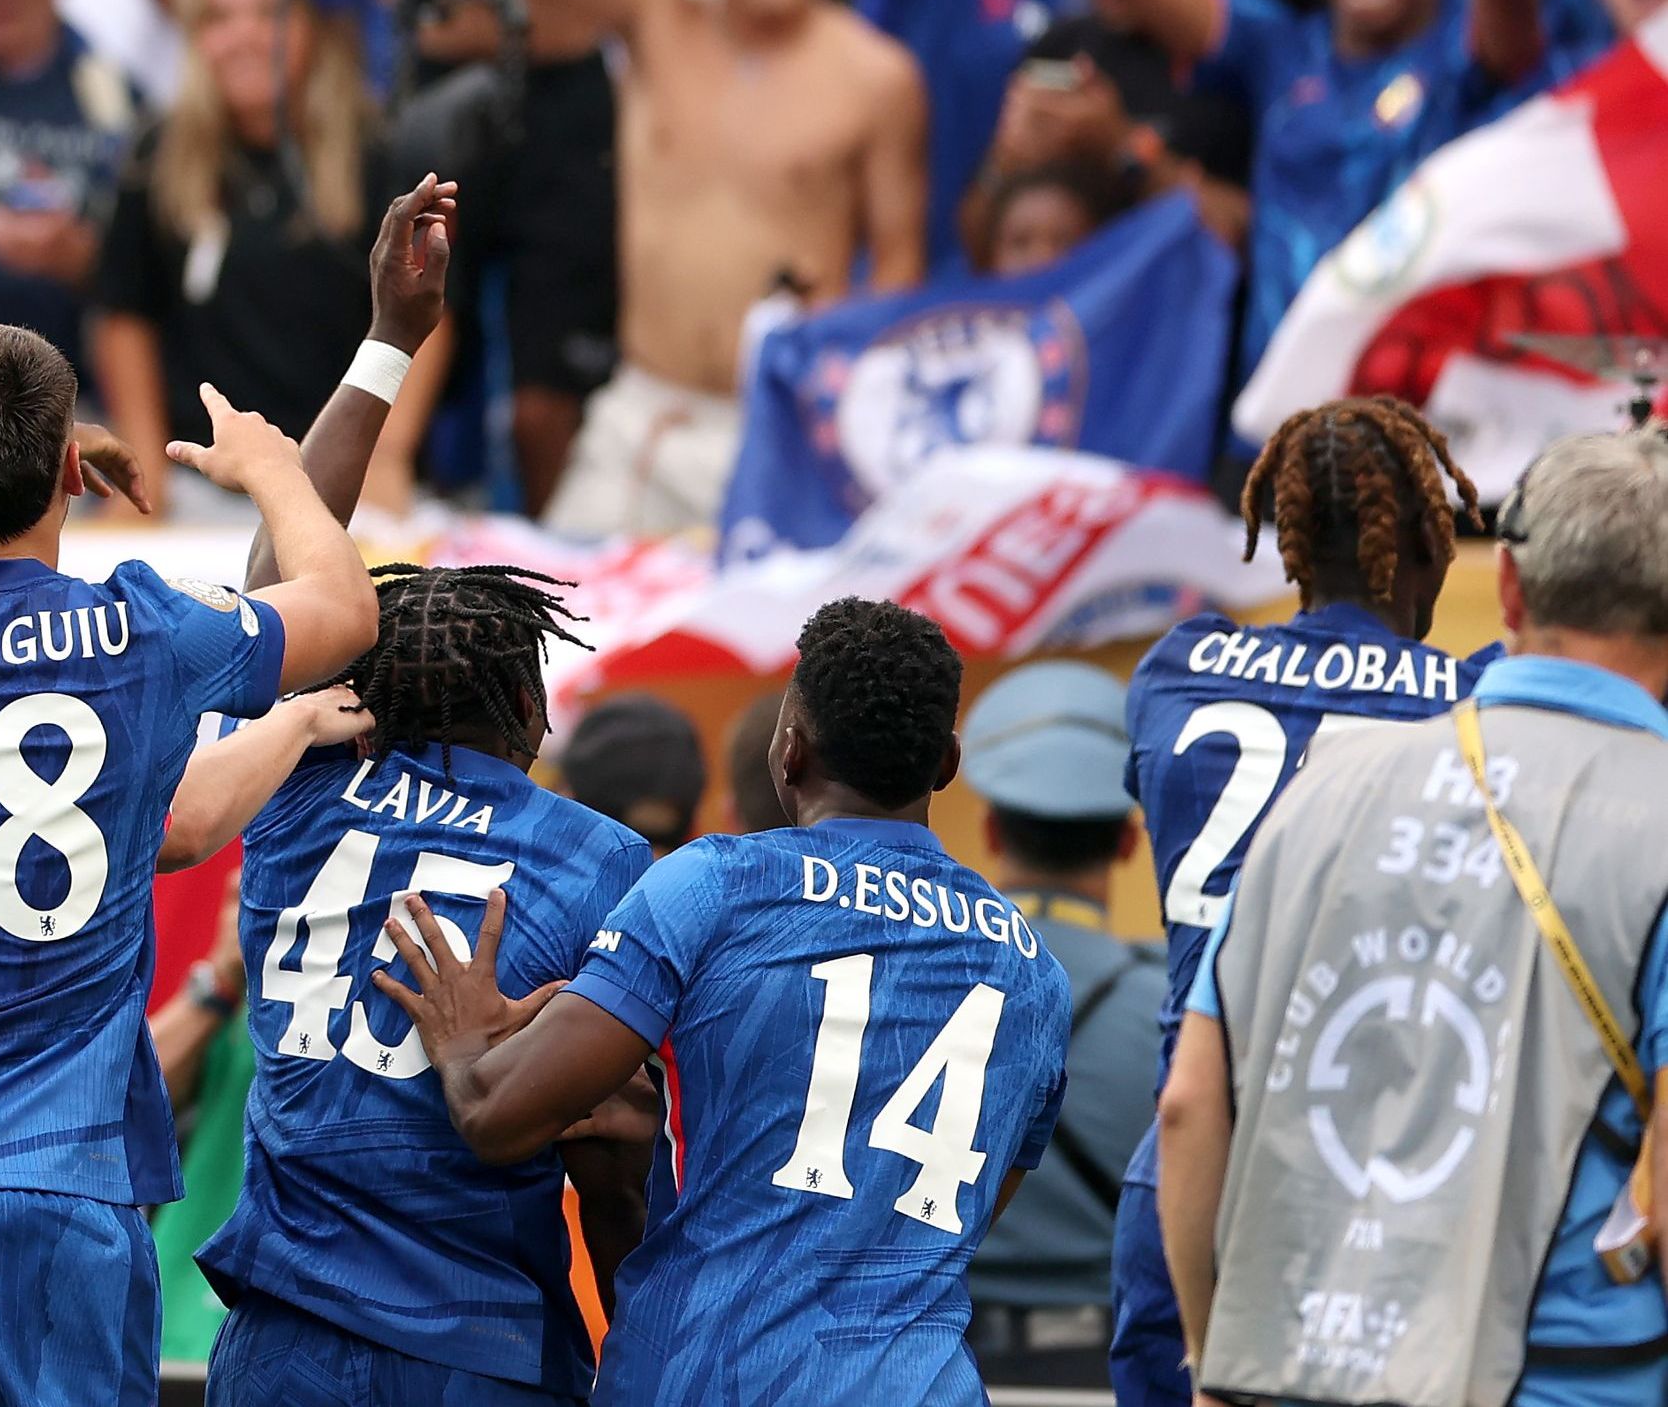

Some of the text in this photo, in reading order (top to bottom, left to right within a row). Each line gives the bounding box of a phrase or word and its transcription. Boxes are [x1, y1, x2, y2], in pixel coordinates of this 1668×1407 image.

[1, 602, 130, 665] GUIU
[1188, 630, 1458, 702] CHALOBAH
[340, 758, 494, 835] LAVIA
[1376, 815, 1502, 889] 334
[801, 855, 1039, 960] D.ESSUGO
[261, 828, 516, 1080] 45
[1265, 961, 1340, 1092] CLUB
[1351, 925, 1506, 1004] WORLD
[771, 953, 1006, 1235] 14
